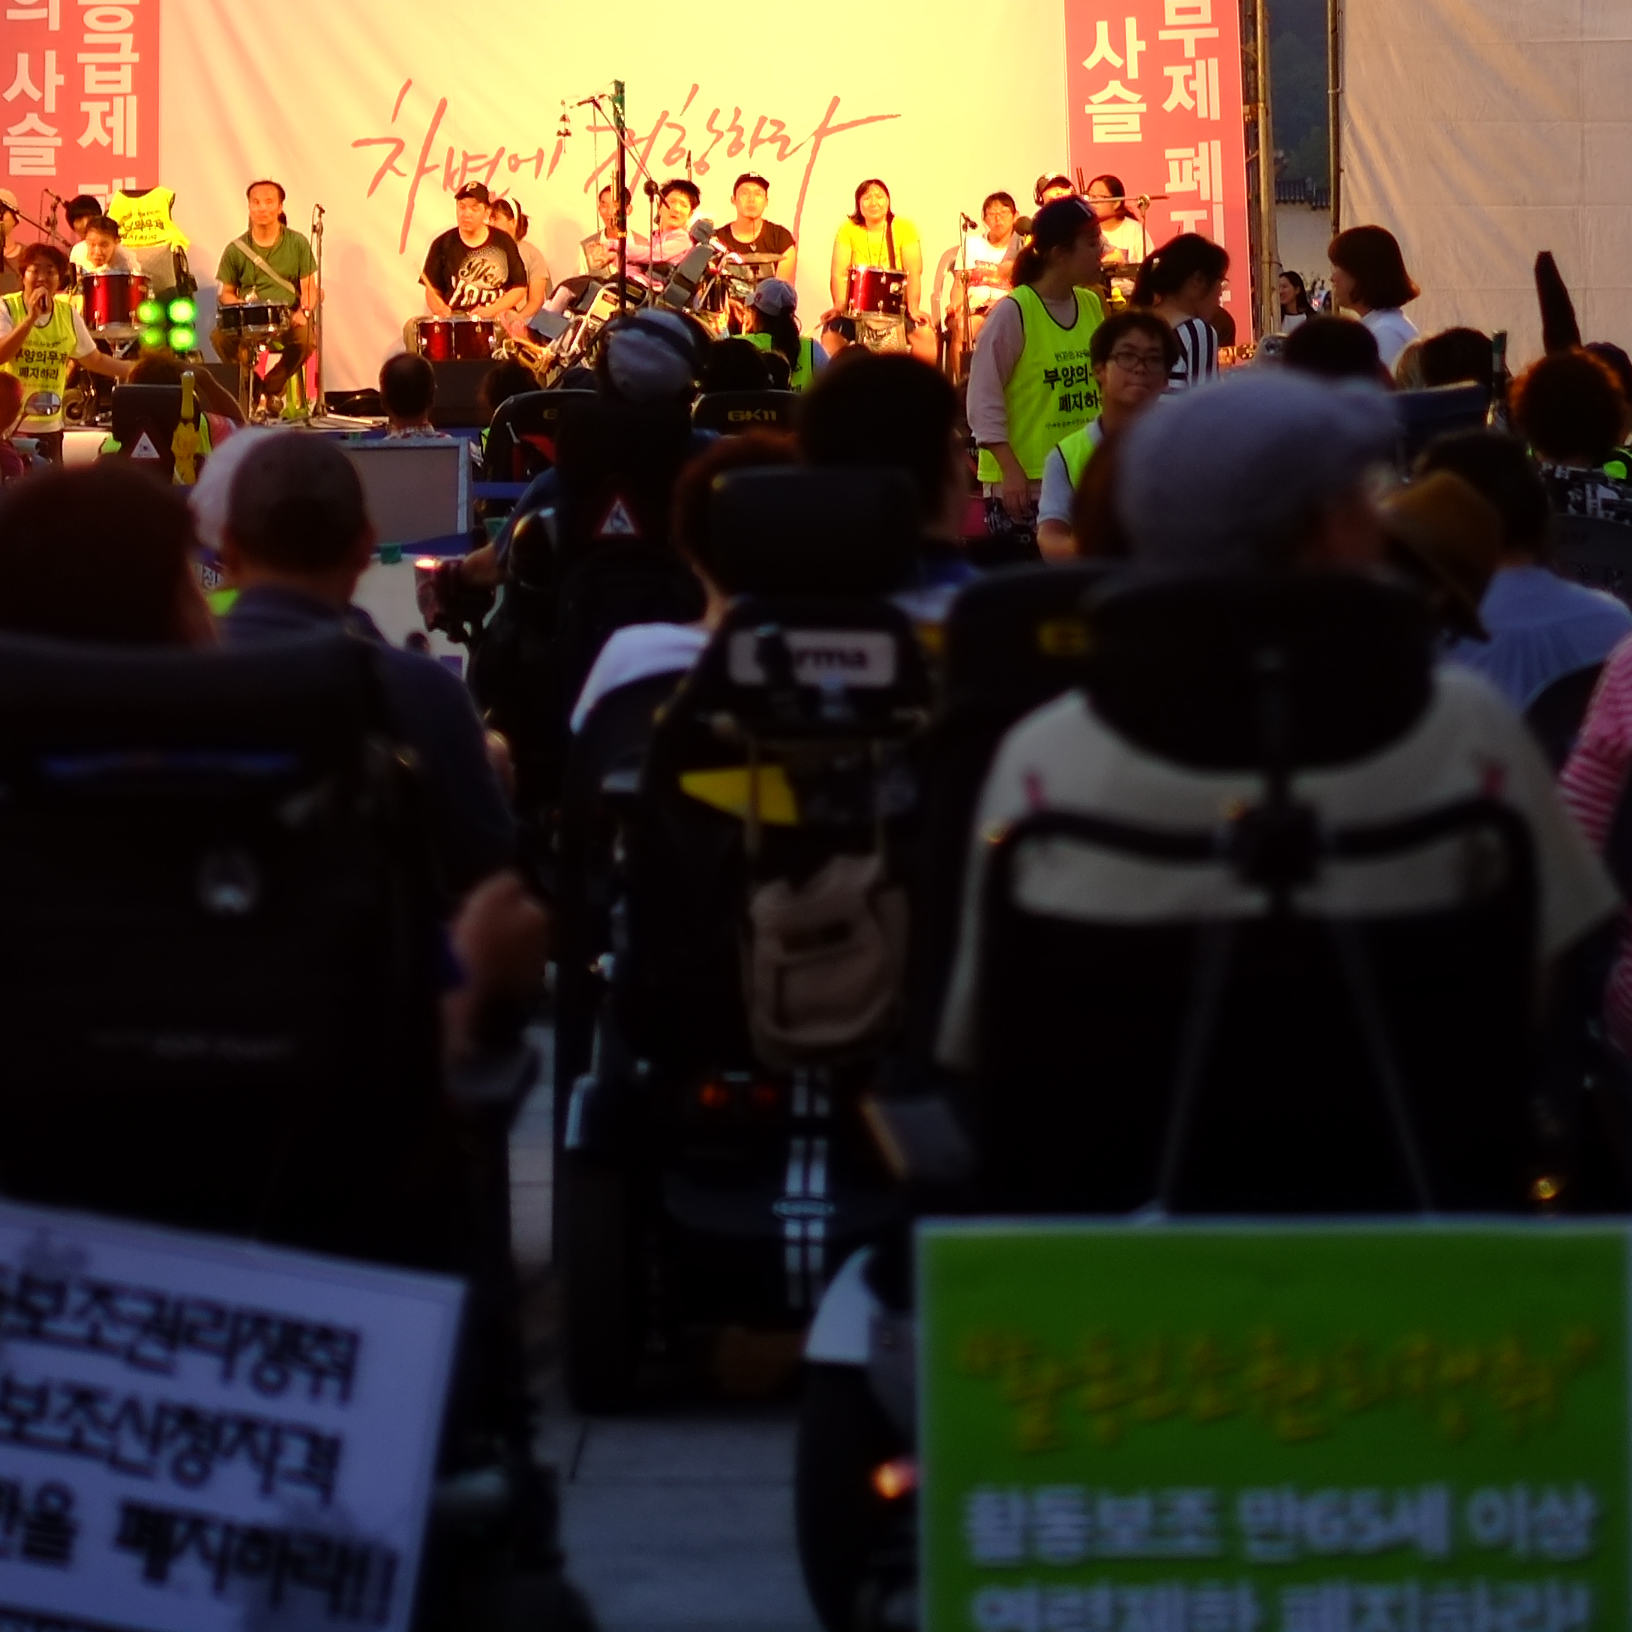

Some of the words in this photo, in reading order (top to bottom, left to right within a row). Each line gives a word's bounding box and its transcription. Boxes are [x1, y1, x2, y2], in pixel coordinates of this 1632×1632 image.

[1, 50, 65, 177] 사슬
[1082, 17, 1148, 144] 사슬
[352, 78, 564, 256] 차별에
[1043, 363, 1092, 390] 부양의
[1059, 390, 1099, 413] 폐지하
